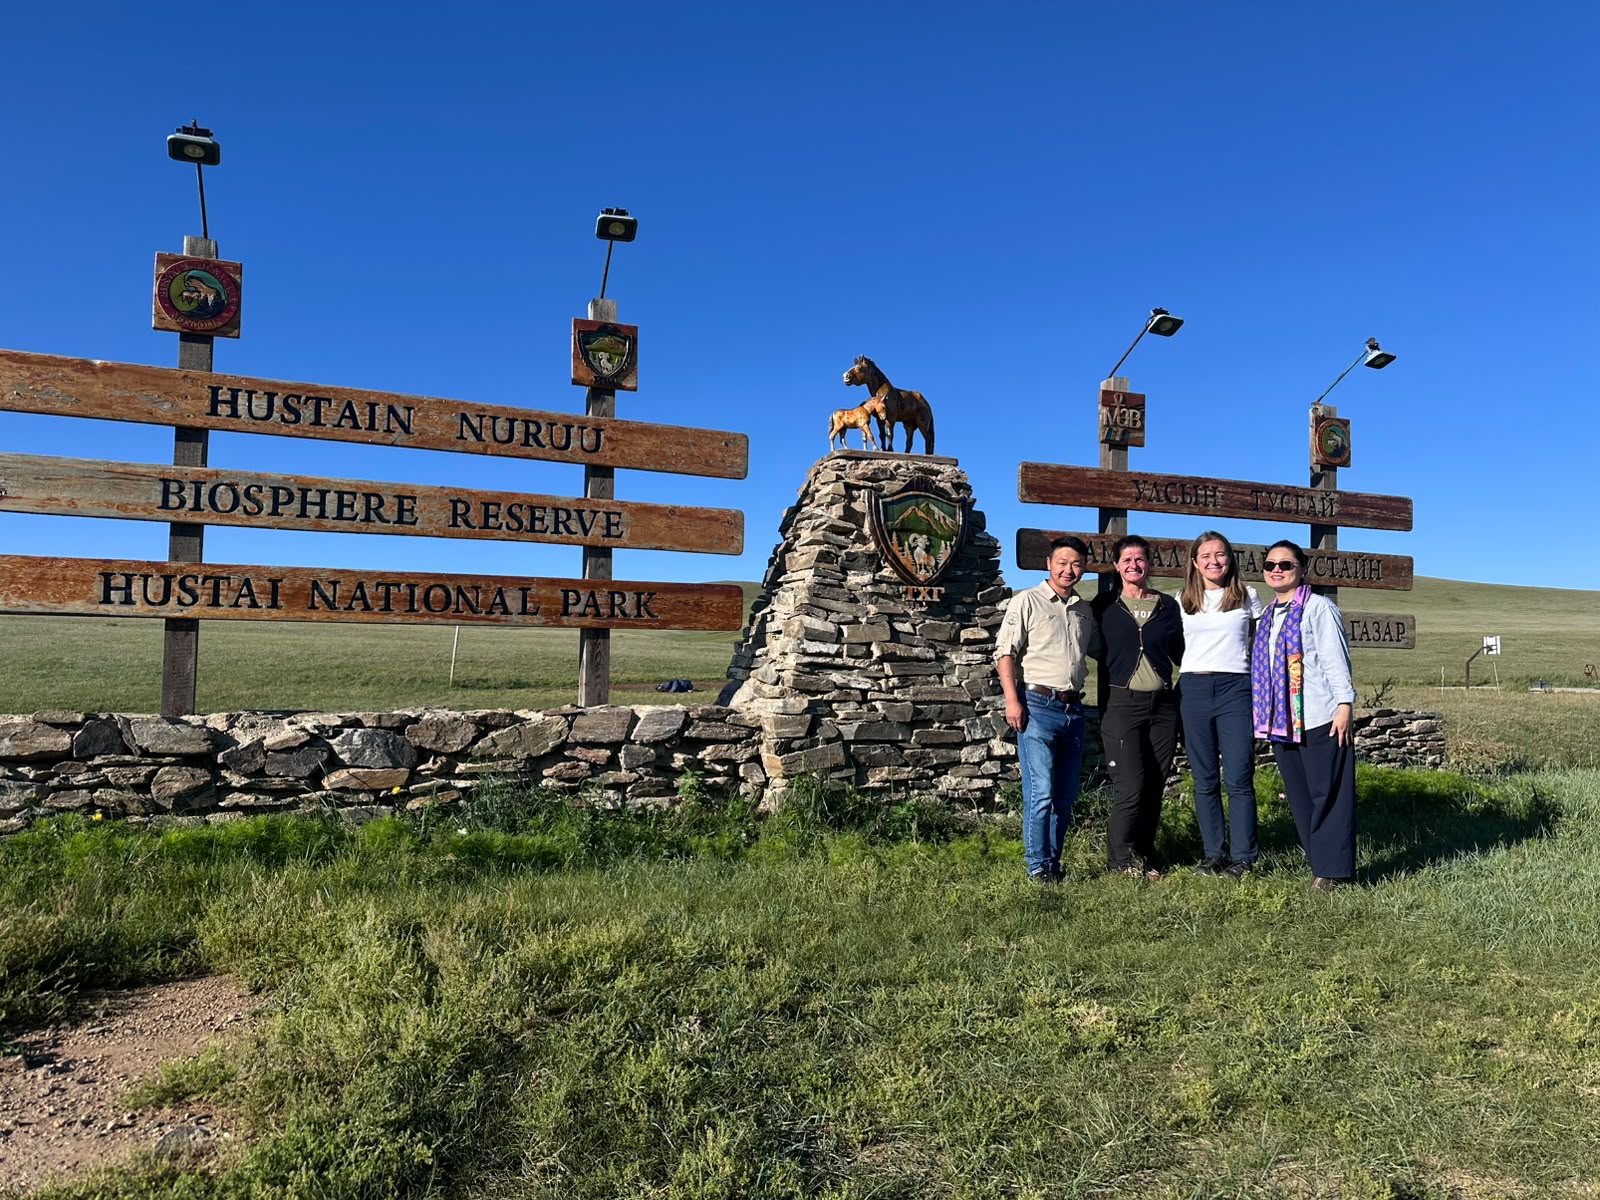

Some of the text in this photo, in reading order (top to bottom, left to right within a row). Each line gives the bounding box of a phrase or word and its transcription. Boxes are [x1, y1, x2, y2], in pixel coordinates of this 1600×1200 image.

[206, 386, 604, 453] HUSTAIN NURUU
[156, 478, 624, 538] BIOSPHERE RESERVE
[1132, 480, 1335, 517] УЛСЫН ТУСГАЙ
[1304, 553, 1383, 580] УСТАЙН
[98, 573, 659, 618] HUSTAI NATIONAL PARK
[1350, 620, 1406, 642] ГАЗАР
